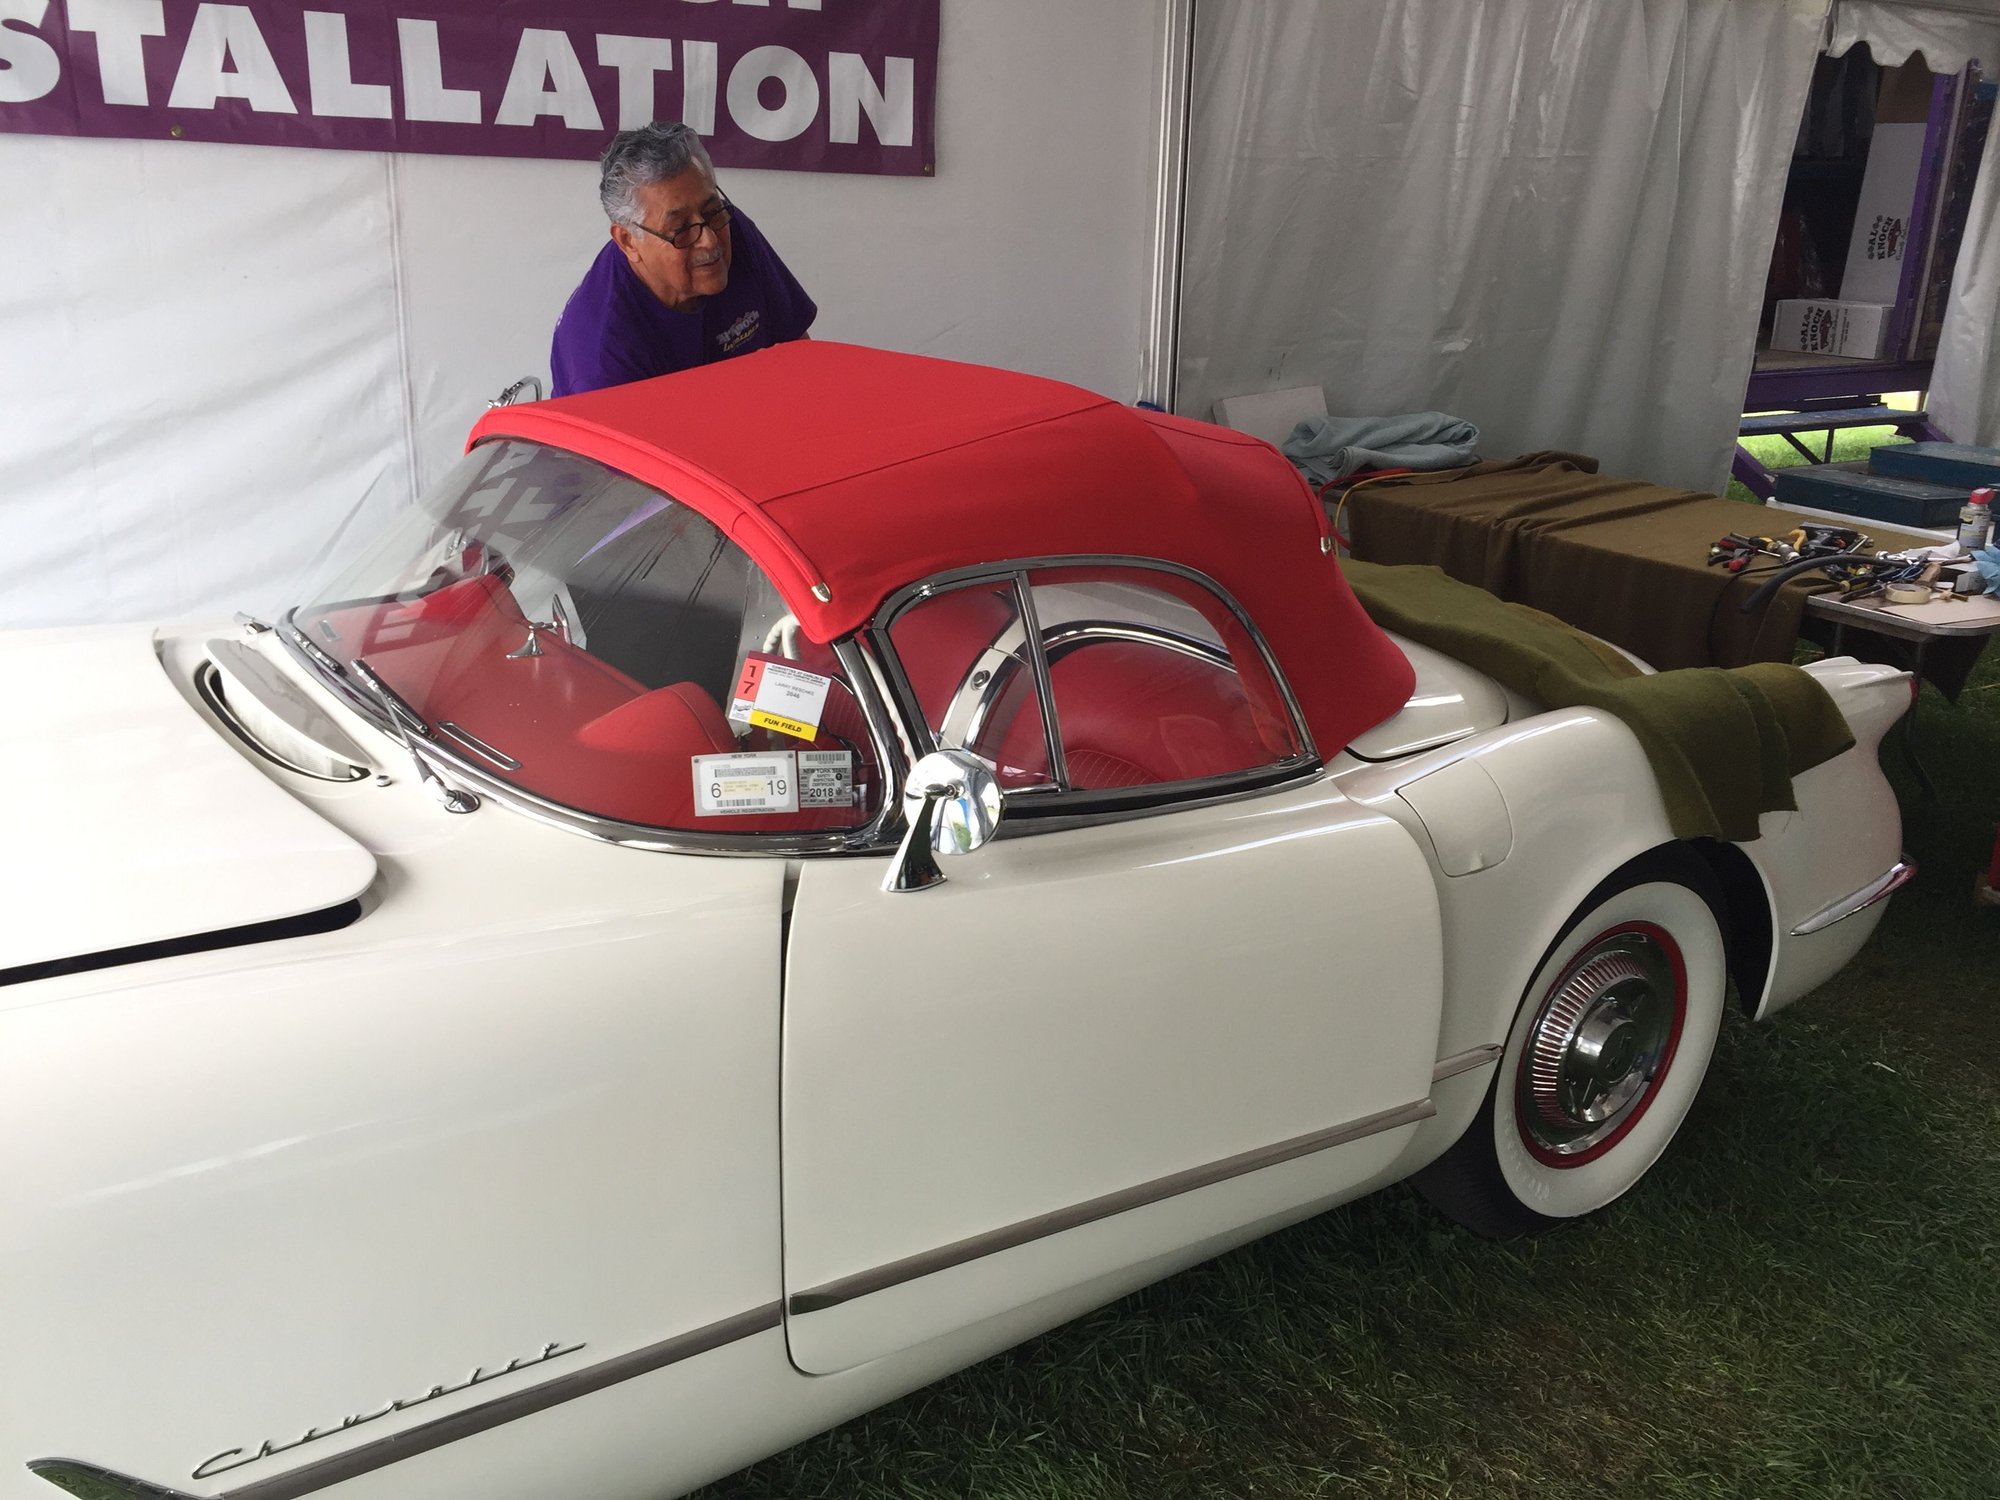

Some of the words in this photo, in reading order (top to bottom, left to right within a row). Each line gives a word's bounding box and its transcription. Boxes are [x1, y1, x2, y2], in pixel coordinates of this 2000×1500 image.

[1877, 216, 1894, 260] KNOCH
[1810, 307, 1825, 352] KNOCH
[749, 665, 757, 678] 1
[743, 681, 755, 694] 7
[763, 717, 780, 726] FUN
[780, 722, 802, 733] FIELD
[711, 783, 722, 798] 6
[767, 779, 787, 796] 19
[810, 788, 834, 798] 2018
[191, 1341, 586, 1479] Chevrolet
